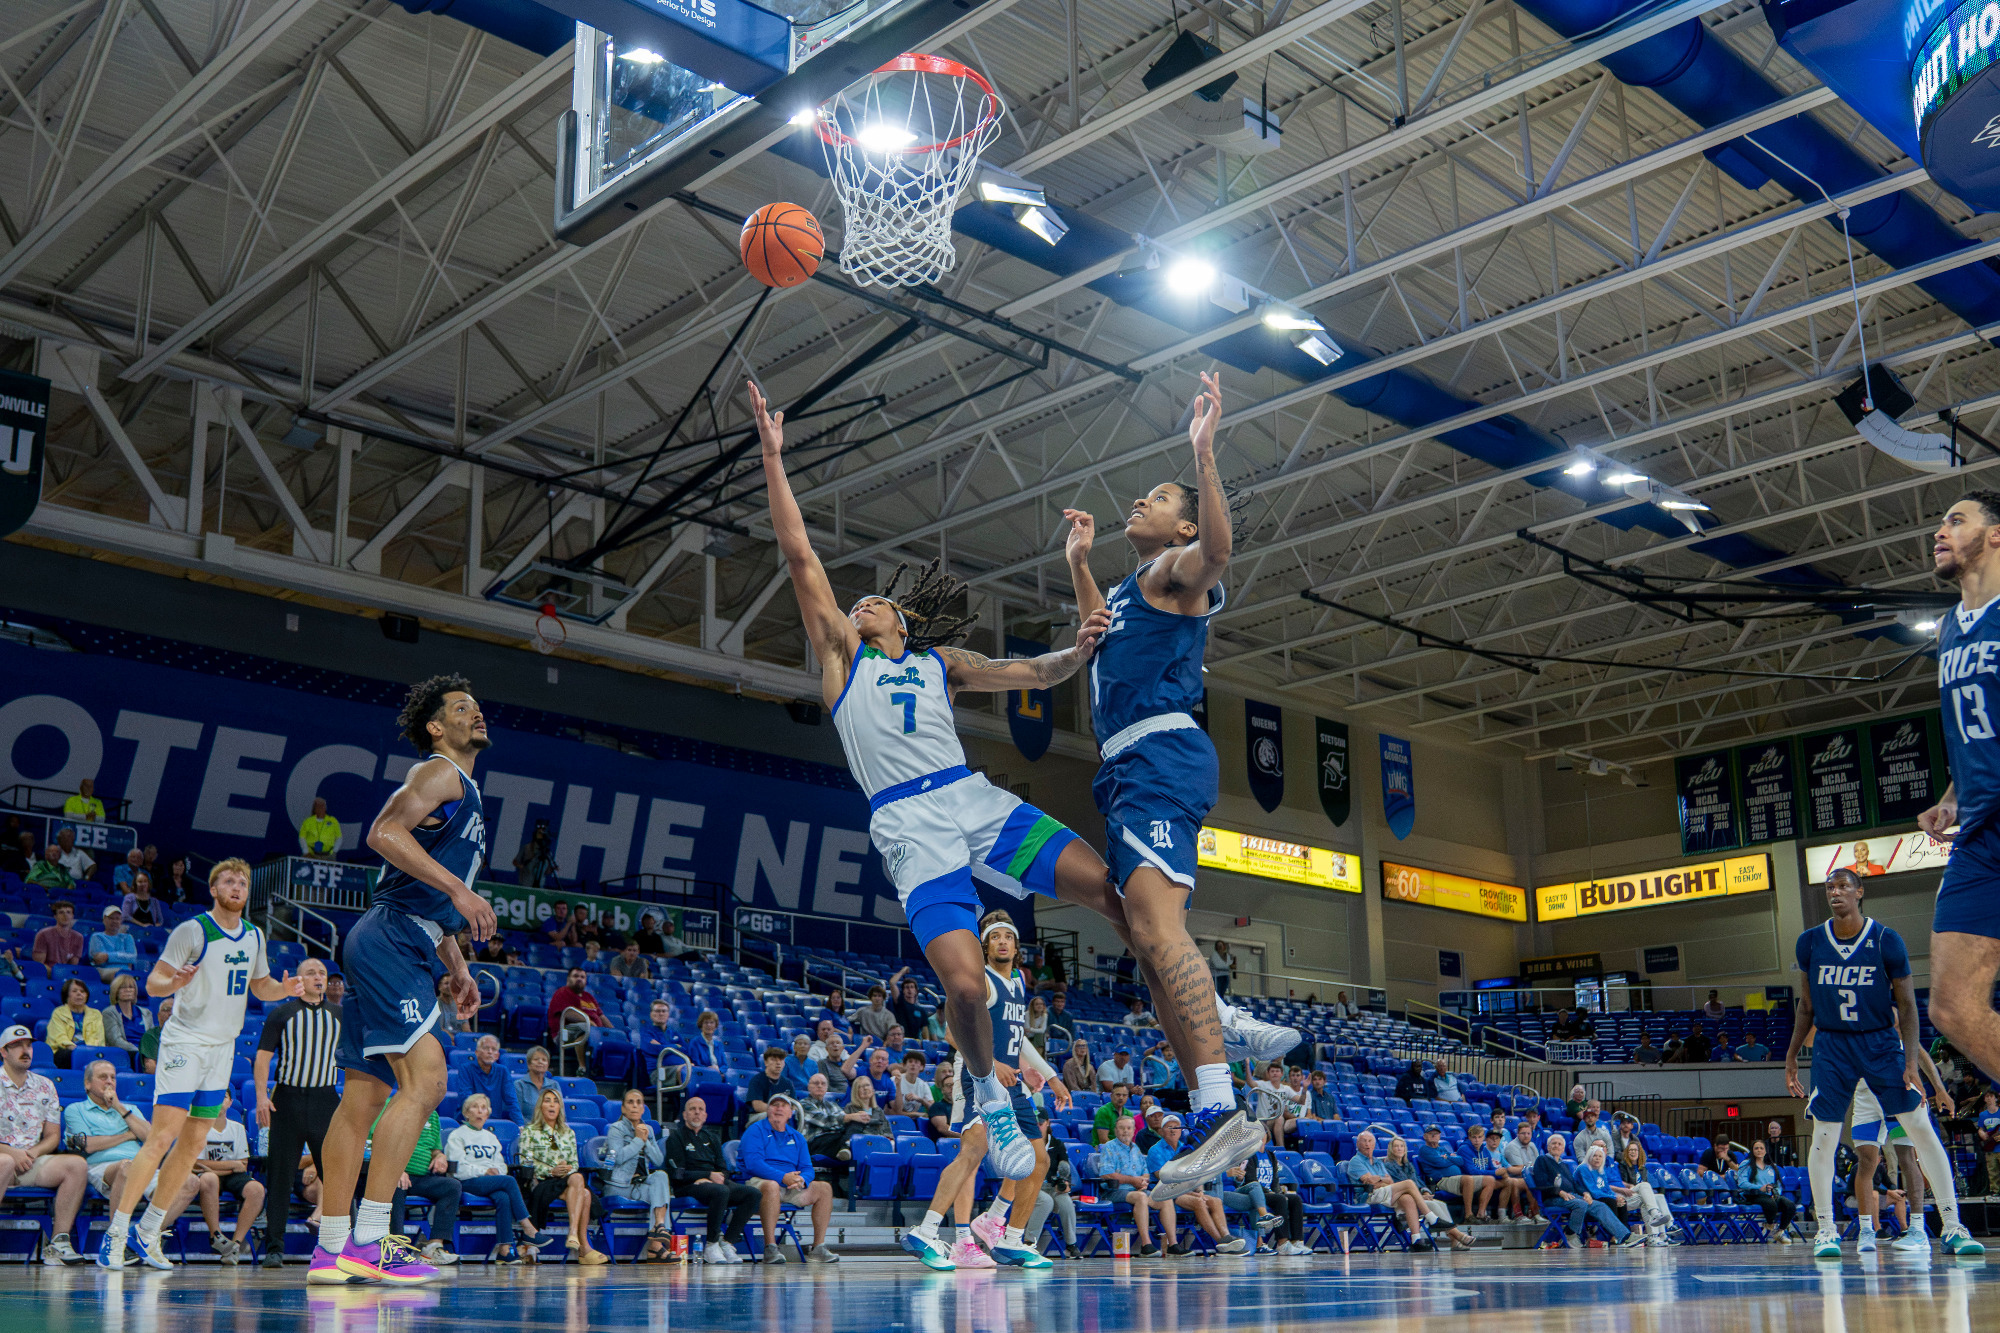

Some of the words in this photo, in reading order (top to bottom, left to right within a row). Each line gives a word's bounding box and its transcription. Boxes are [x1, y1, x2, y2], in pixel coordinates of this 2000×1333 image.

[681, 5, 690, 17] by
[691, 10, 717, 28] Design
[1938, 640, 2000, 689] RICE
[876, 666, 925, 689] Eagles
[890, 692, 917, 735] 7
[1952, 683, 1996, 744] 13
[1251, 716, 1277, 731] QUEENS
[1319, 733, 1346, 748] STETSON
[1879, 732, 1921, 756] FGCU
[1811, 744, 1852, 768] FGCU
[1747, 755, 1785, 777] FGCU
[1889, 760, 1916, 774] NCAA
[1686, 767, 1724, 788] FGCU
[1821, 772, 1847, 786] NCAA
[1877, 769, 1930, 786] TOURNAMENT
[1756, 782, 1780, 797] NCAA
[1810, 781, 1860, 797] TOURNAMENT
[1910, 789, 1927, 799] 2017
[1696, 793, 1719, 807] NCAA
[1745, 791, 1792, 807] TOURNAMENT
[1774, 801, 1790, 810] 2012
[1815, 795, 1832, 805] 2004
[1686, 802, 1730, 817] TOURNAMENT
[1842, 807, 1860, 817] 2022
[1817, 819, 1835, 829] 2023
[1843, 815, 1861, 825] 2024
[75, 824, 109, 849] EE
[482, 770, 706, 894] THE
[1241, 835, 1302, 858] SKILLETS
[312, 866, 344, 888] FF
[1733, 875, 1742, 884] TO
[1743, 872, 1762, 883] ENJOY
[1739, 865, 1754, 874] EASY
[1398, 870, 1420, 898] 60
[1580, 881, 1635, 909] BUD
[1640, 868, 1720, 900] LIGHT
[1480, 888, 1517, 904] CROWTHER
[1545, 895, 1560, 903] EASY
[1560, 894, 1568, 902] TO
[1484, 901, 1515, 914] ROOFING
[1549, 902, 1566, 911] DRINK
[751, 913, 774, 933] GG
[1527, 962, 1552, 974] BEER
[1565, 957, 1593, 970] WINE
[227, 970, 248, 996] 15
[1817, 965, 1877, 986] RICE
[1838, 989, 1859, 1022] 2
